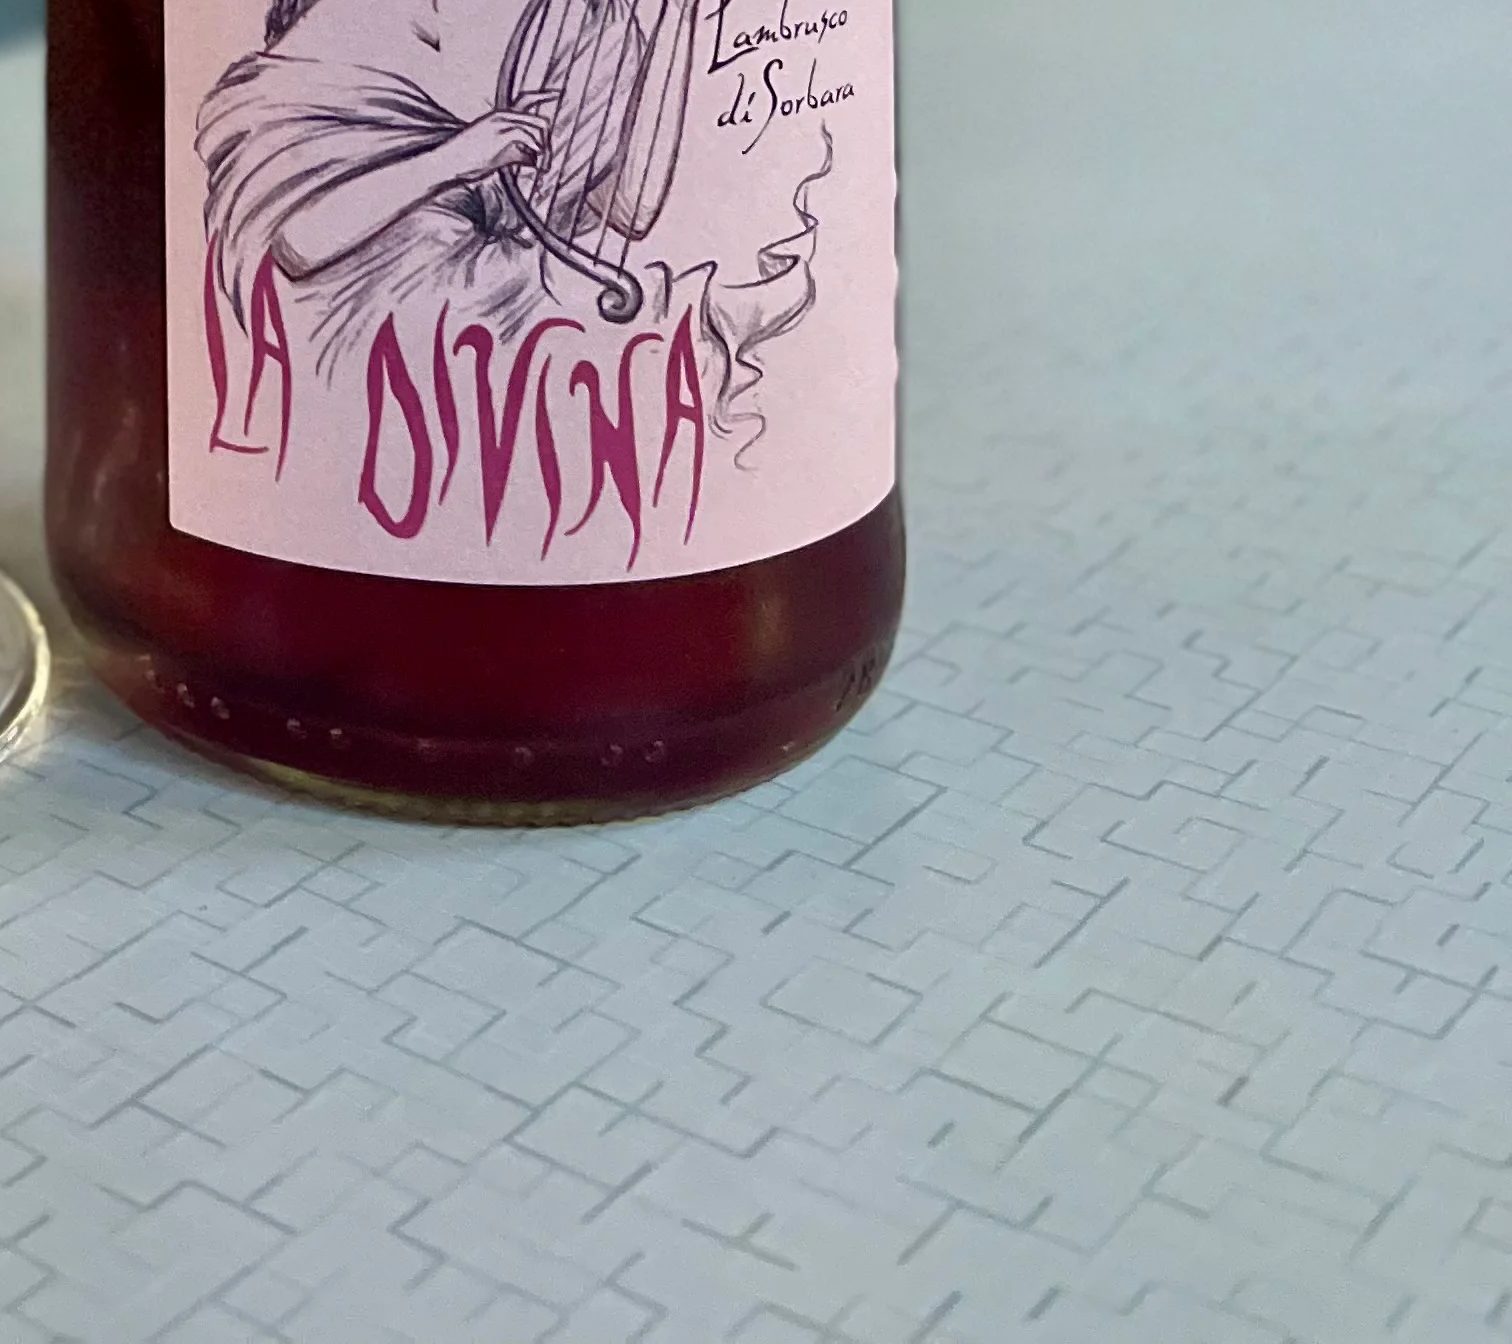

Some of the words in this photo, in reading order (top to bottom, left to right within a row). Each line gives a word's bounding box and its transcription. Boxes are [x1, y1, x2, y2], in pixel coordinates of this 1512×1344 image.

[717, 72, 756, 127] di
[742, 58, 855, 155] Sorbara
[202, 228, 291, 483] LA
[357, 299, 706, 574] DIVINA
